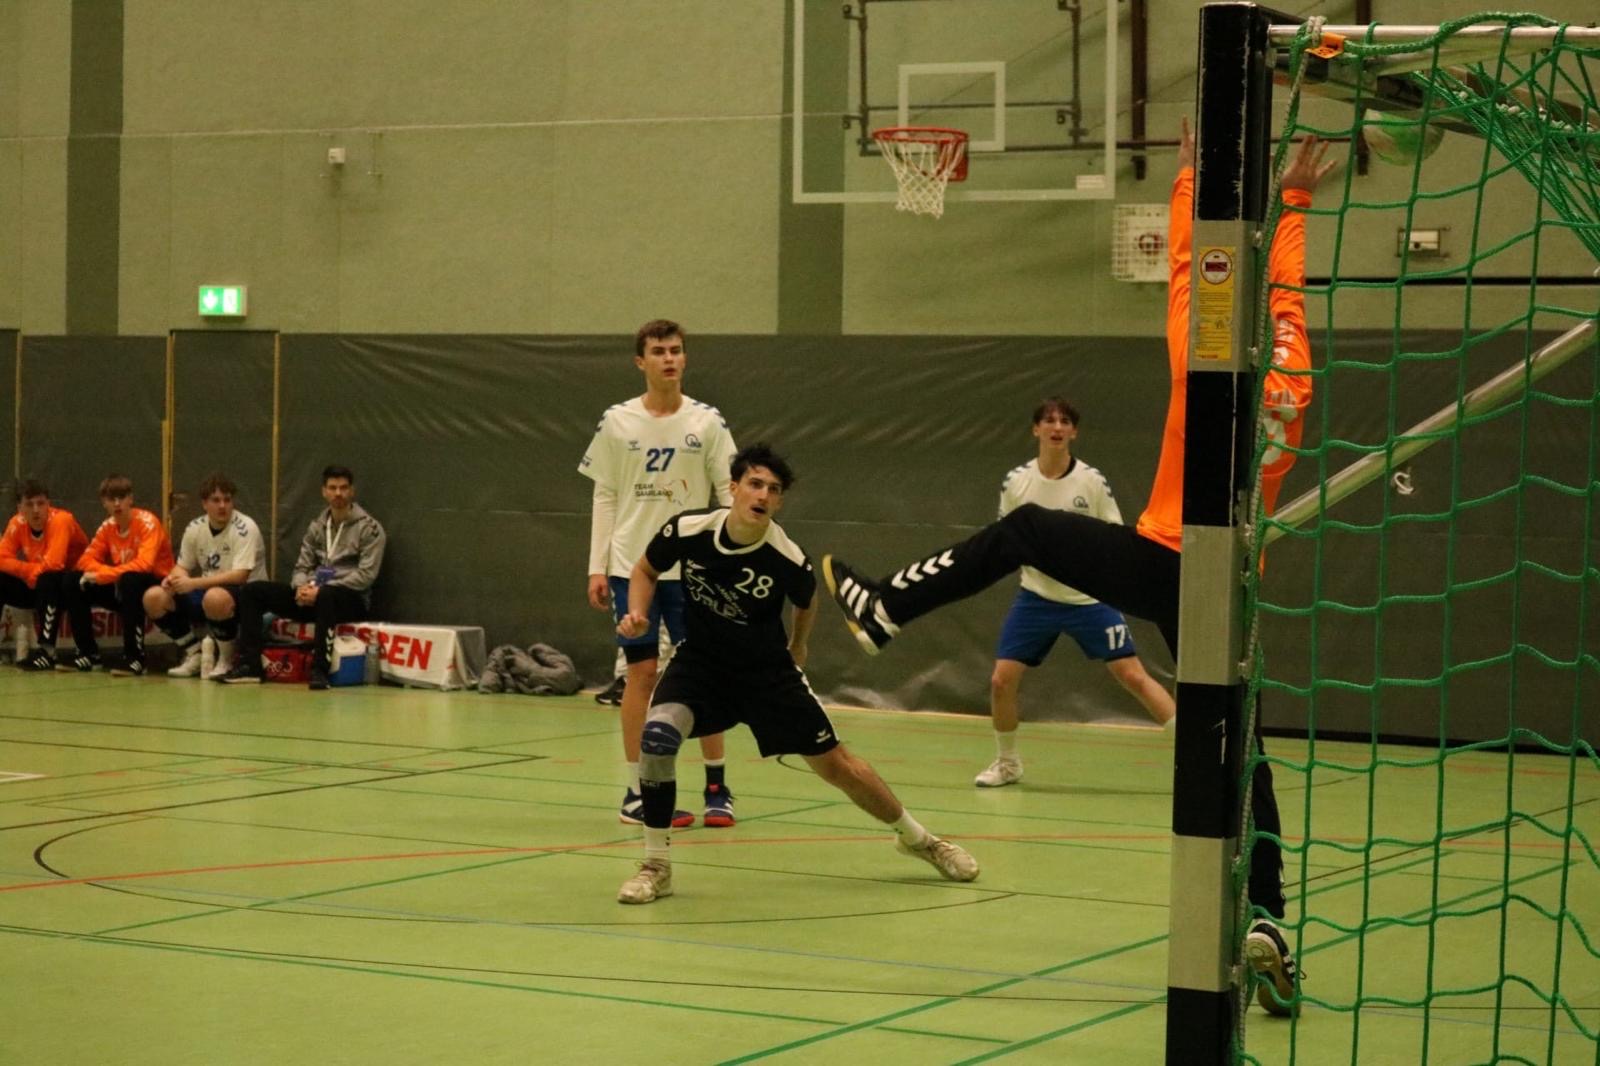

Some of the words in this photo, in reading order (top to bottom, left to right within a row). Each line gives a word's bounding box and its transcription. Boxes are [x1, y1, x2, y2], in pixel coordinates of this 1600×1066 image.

[646, 447, 675, 472] 27
[734, 567, 774, 599] 28
[1105, 624, 1126, 650] 17
